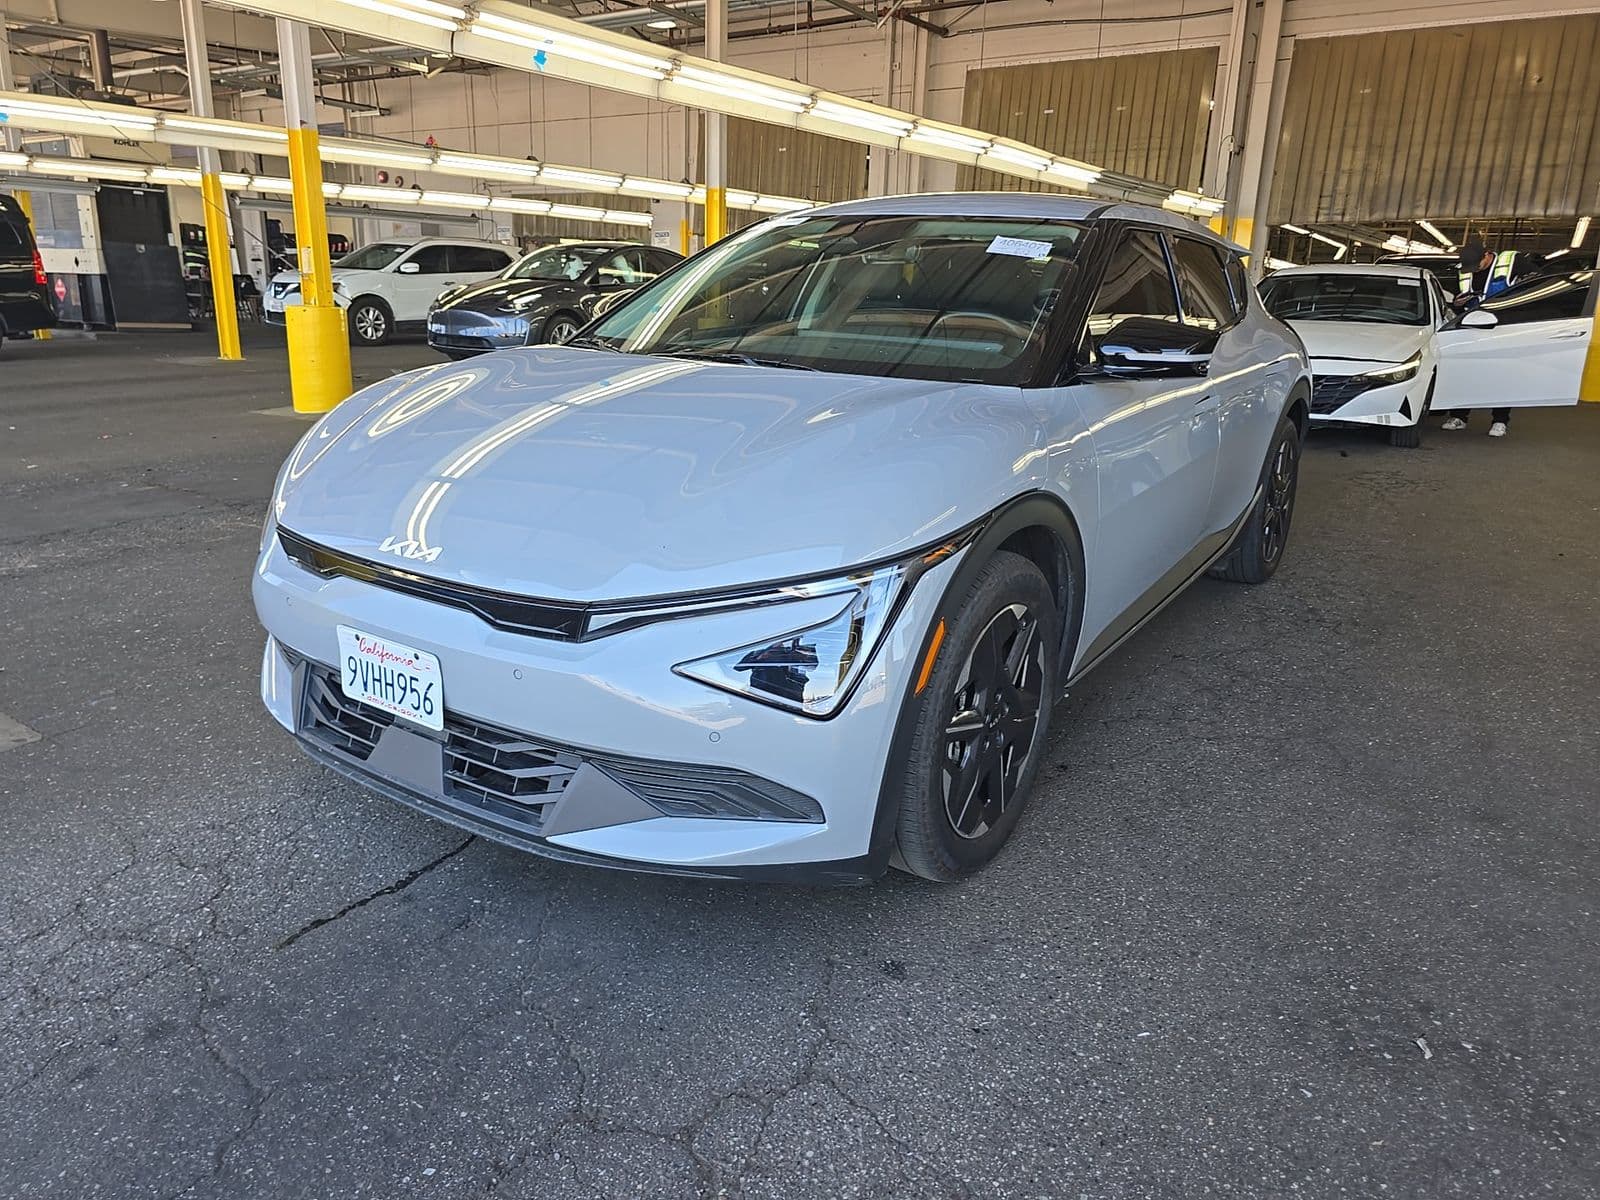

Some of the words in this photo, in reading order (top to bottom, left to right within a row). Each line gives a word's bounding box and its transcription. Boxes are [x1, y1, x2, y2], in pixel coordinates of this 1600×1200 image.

[378, 535, 443, 563] KIA
[359, 637, 415, 665] California
[347, 655, 434, 716] 9VHH956
